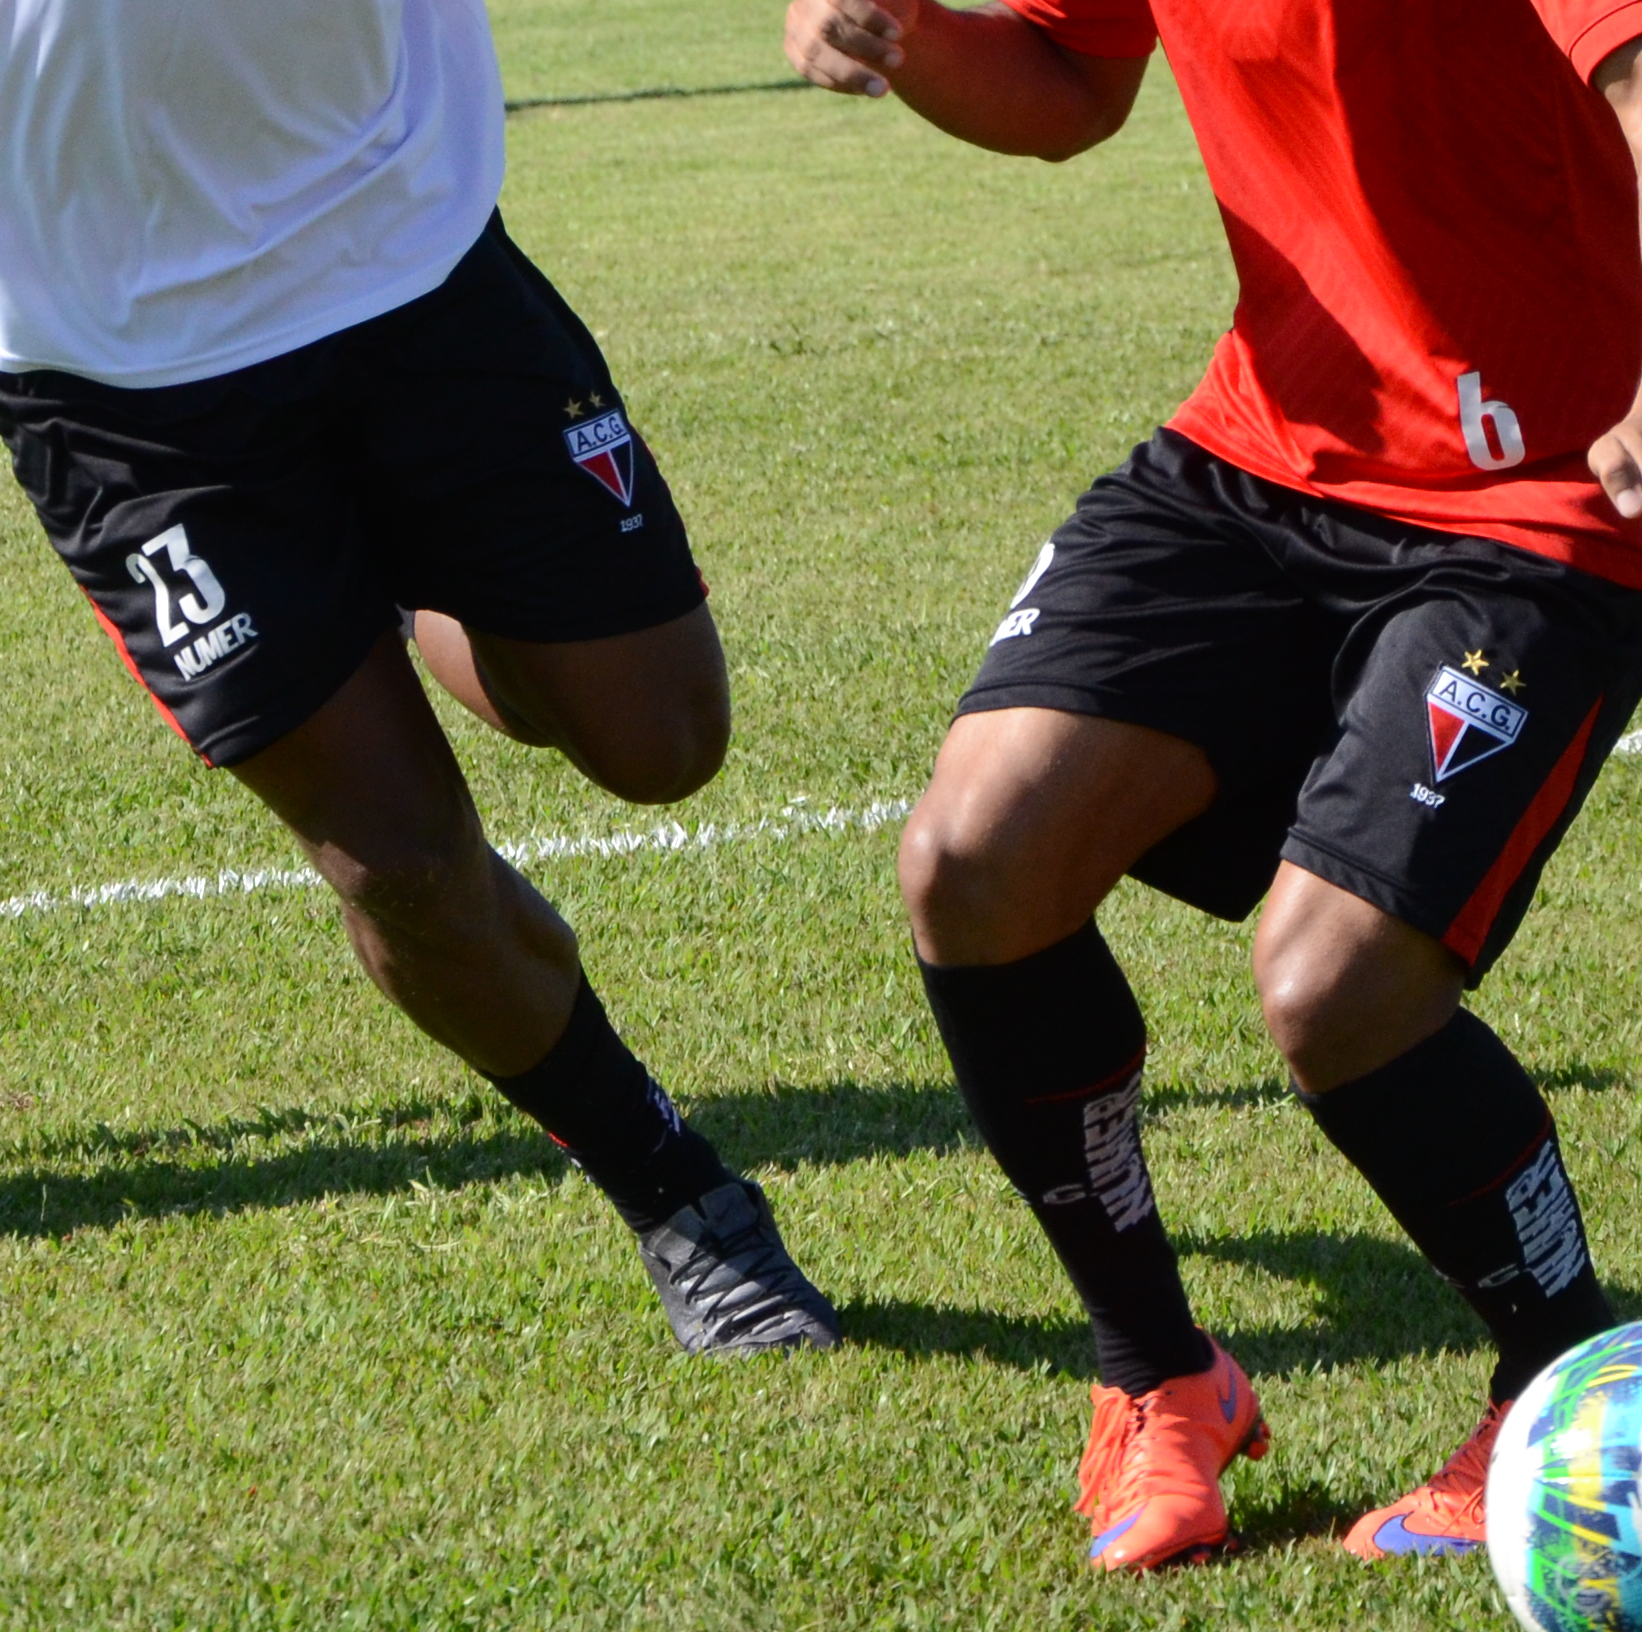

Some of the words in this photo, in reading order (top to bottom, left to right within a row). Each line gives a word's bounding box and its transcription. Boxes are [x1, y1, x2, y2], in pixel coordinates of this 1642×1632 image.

[1457, 371, 1526, 471] 6
[620, 513, 644, 533] 1937
[125, 522, 226, 648] 23
[173, 611, 258, 681] NUMER
[1438, 679, 1512, 731] A.C.G.
[1410, 782, 1446, 809] 1937
[1506, 1139, 1587, 1299] NUMER
